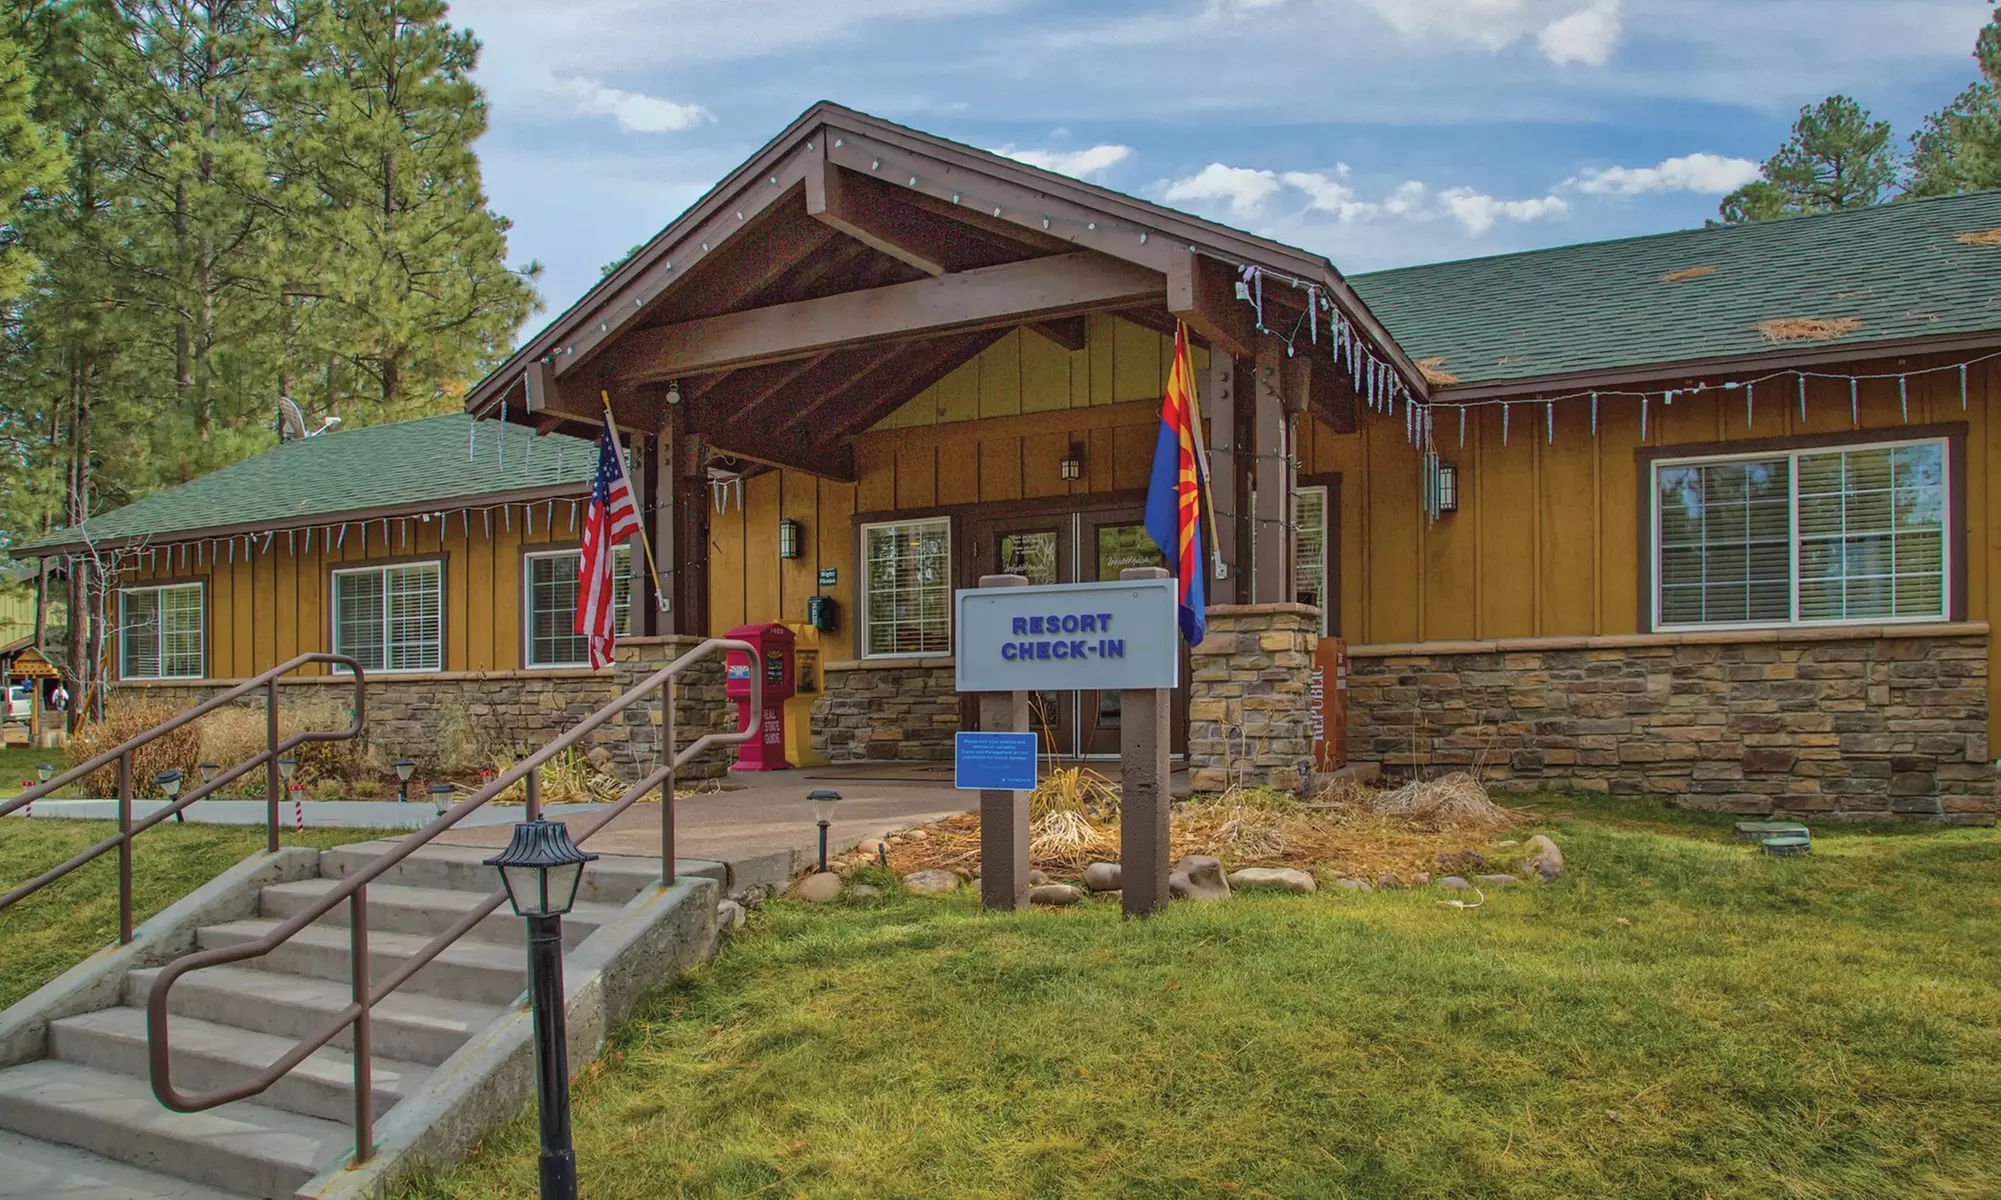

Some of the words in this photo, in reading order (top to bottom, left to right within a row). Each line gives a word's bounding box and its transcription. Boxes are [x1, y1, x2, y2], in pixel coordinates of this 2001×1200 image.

[1012, 613, 1112, 635] RESORT
[1001, 639, 1125, 660] CHECK-IN
[1310, 665, 1324, 741] REPUBLIC
[764, 732, 781, 745] GUIDE
